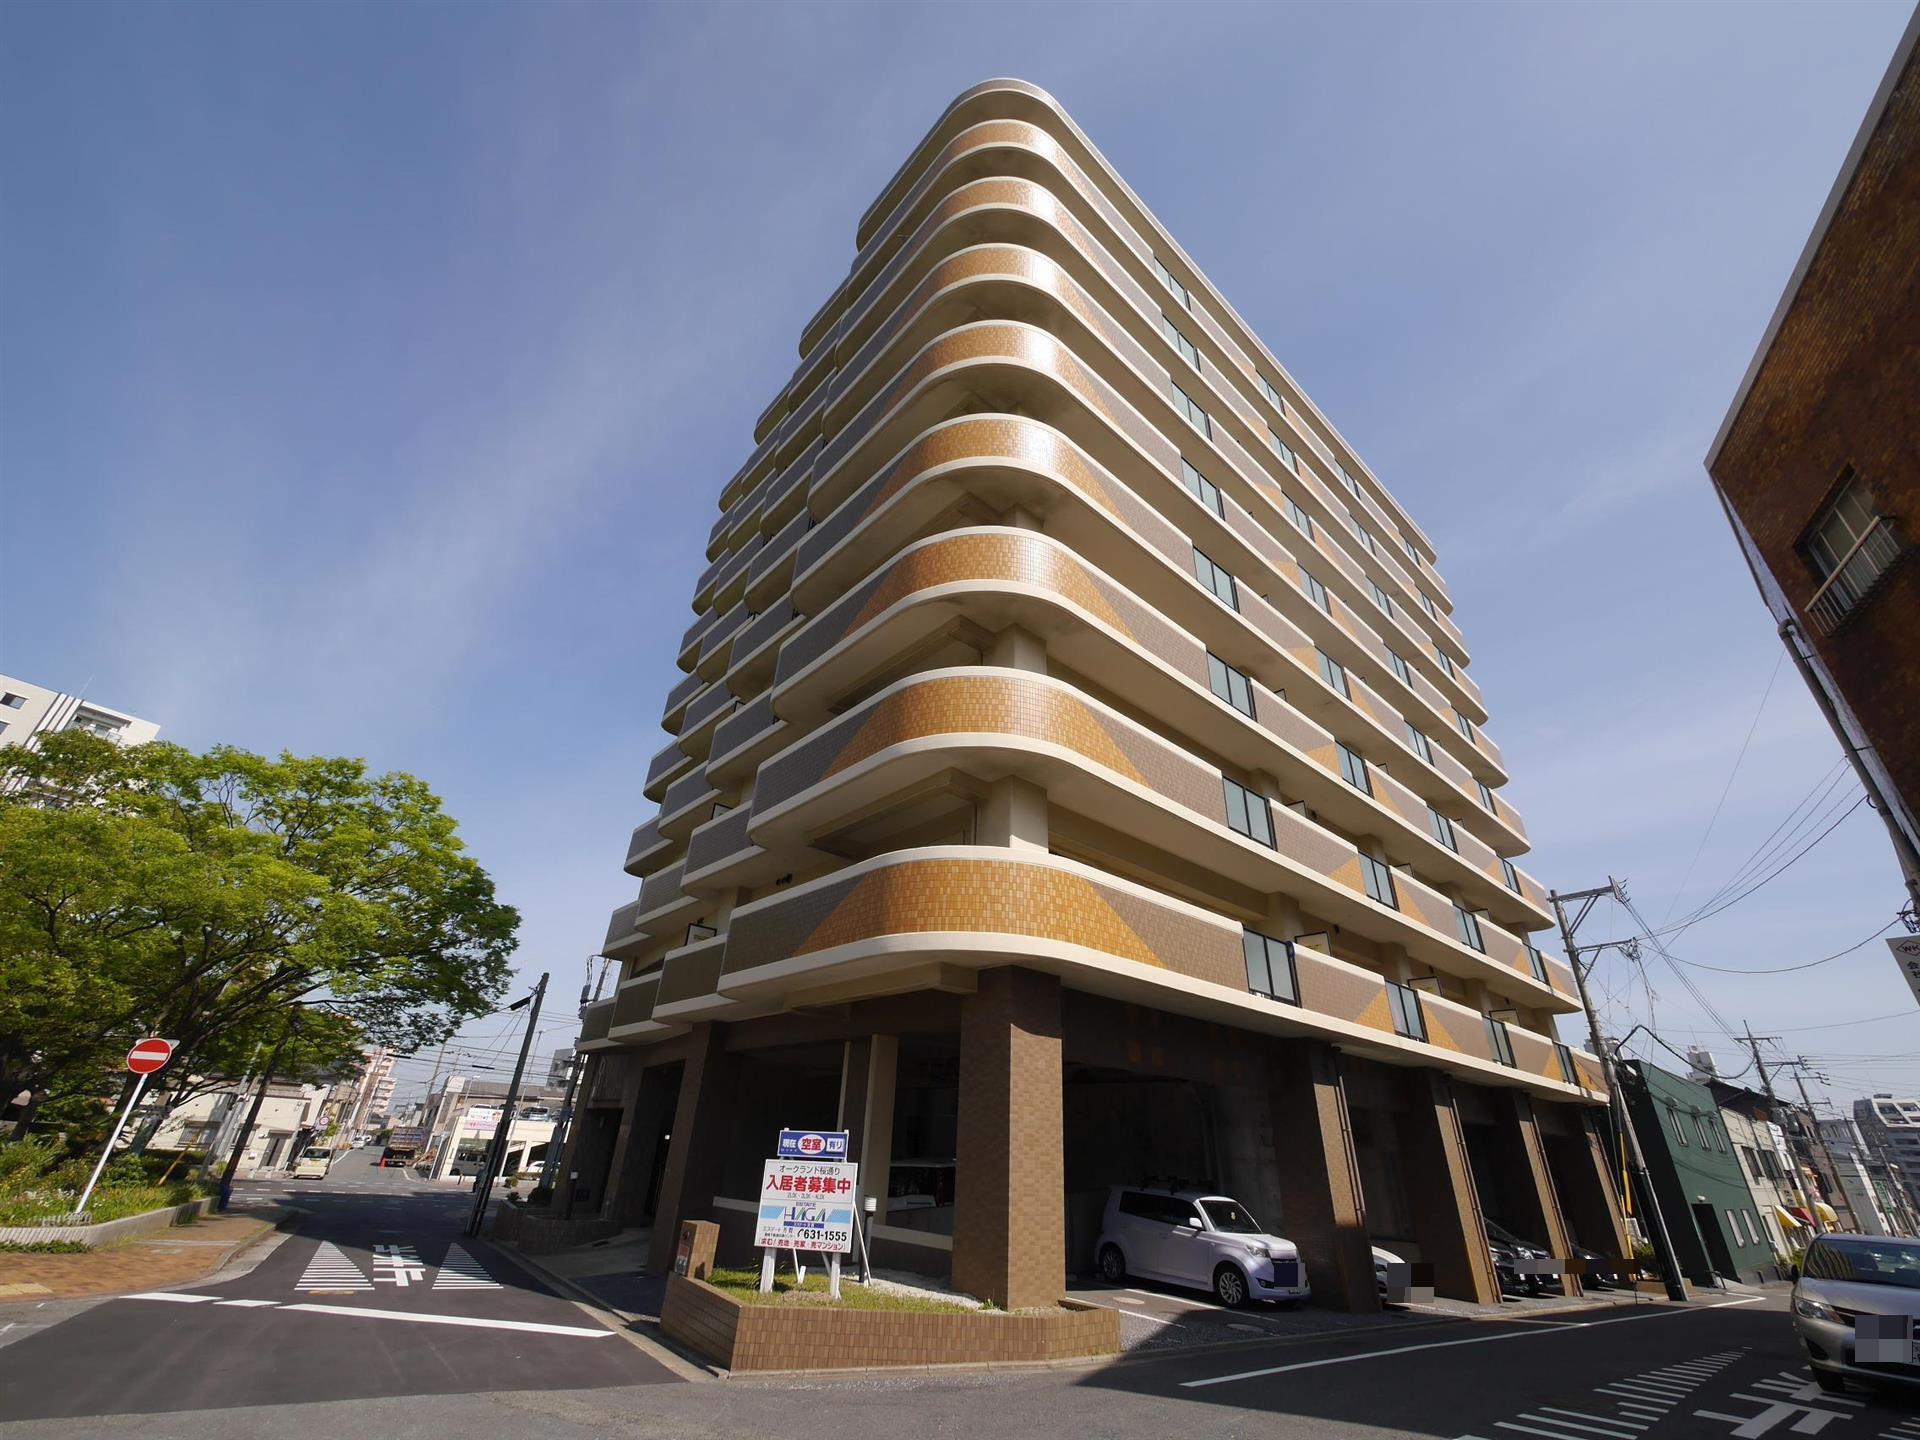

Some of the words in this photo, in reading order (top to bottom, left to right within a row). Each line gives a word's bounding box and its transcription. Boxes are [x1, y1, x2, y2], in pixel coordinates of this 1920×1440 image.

[801, 1138, 822, 1150] 空室
[829, 1141, 842, 1149] 有り
[779, 1165, 840, 1175] オークランド桜通り
[766, 1175, 851, 1194] 入居者募集中
[784, 1206, 826, 1222] HAGA
[803, 1229, 847, 1241] 631-1555
